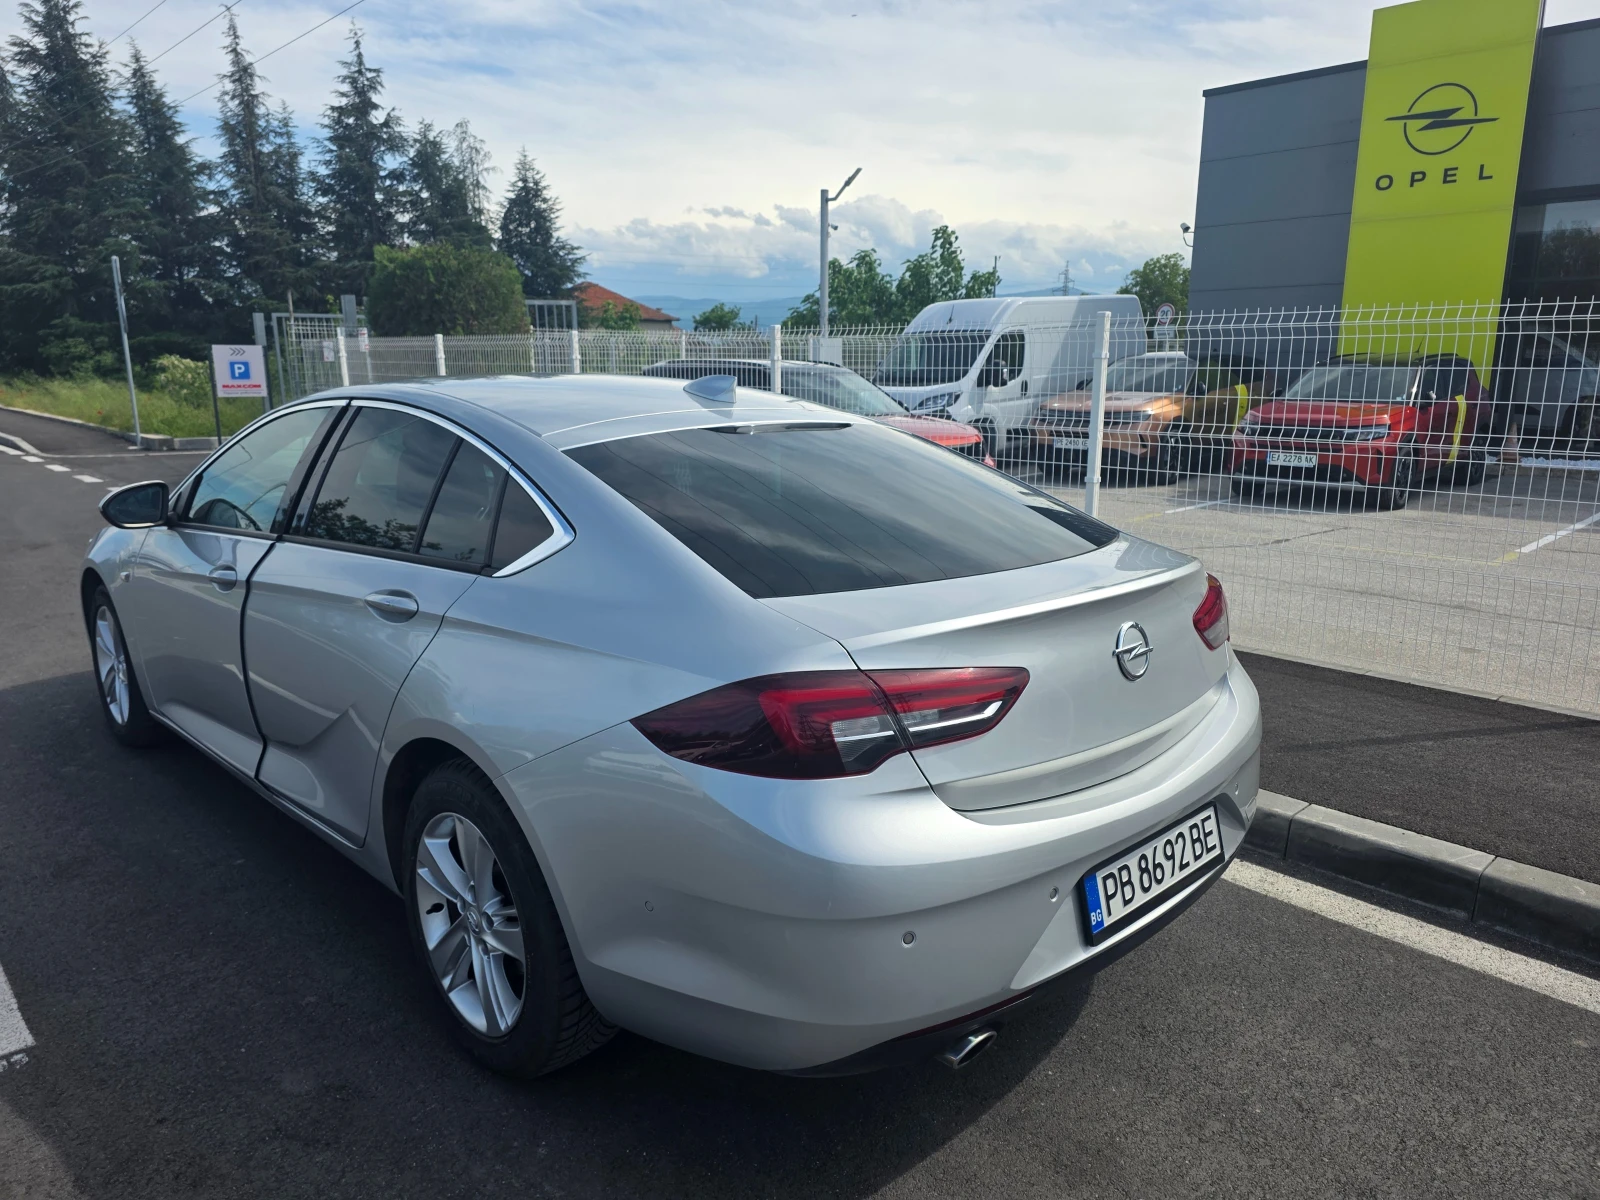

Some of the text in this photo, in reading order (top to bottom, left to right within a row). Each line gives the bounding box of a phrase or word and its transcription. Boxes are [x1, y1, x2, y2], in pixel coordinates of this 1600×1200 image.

[1375, 163, 1494, 191] OPEL
[234, 363, 245, 378] P
[1101, 813, 1218, 919] PB 8692 BE
[1091, 908, 1103, 925] BG
